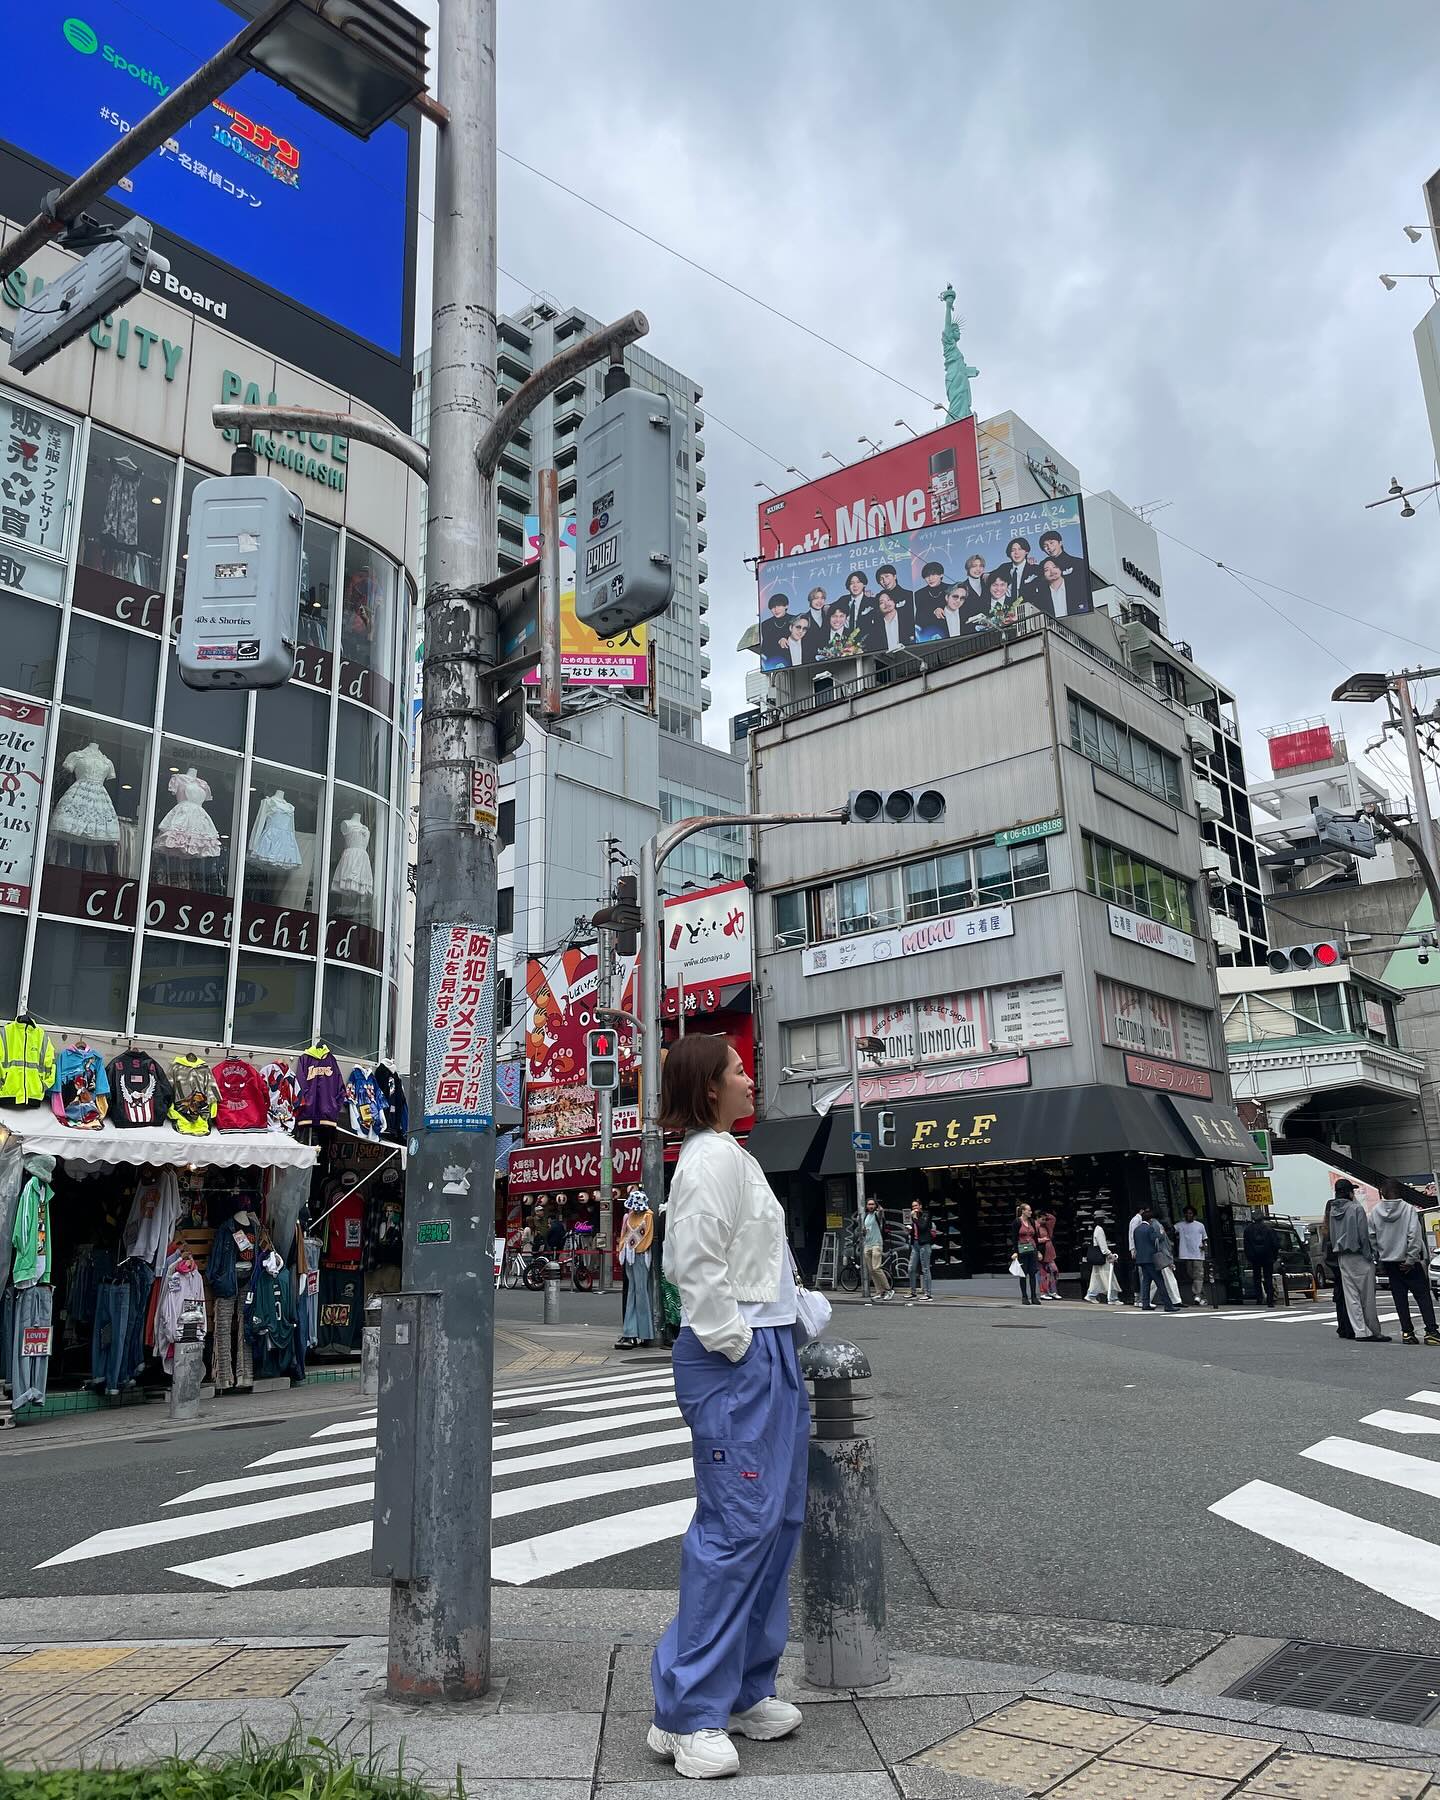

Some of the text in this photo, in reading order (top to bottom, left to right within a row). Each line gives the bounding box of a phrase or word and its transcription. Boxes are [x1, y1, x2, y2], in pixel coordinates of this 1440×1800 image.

[102, 45, 170, 97] Spotify
[230, 111, 300, 169] コナン
[164, 276, 228, 320] Board
[89, 313, 183, 383] CITY
[836, 488, 926, 545] Move
[1010, 519, 1068, 538] RELEASE
[849, 554, 902, 572] RELEASE
[218, 616, 251, 625] Shorties
[901, 915, 1001, 956] MUMU 古着屋
[1136, 922, 1164, 945] MUMU
[433, 927, 469, 1029] 安心を見守る
[436, 934, 491, 1105] 防犯カメラ天国
[462, 1037, 488, 1110] アメリカ村
[538, 1147, 642, 1181] しばいたか!!
[911, 1136, 991, 1151] Face to Face
[23, 1343, 48, 1355] SALE
